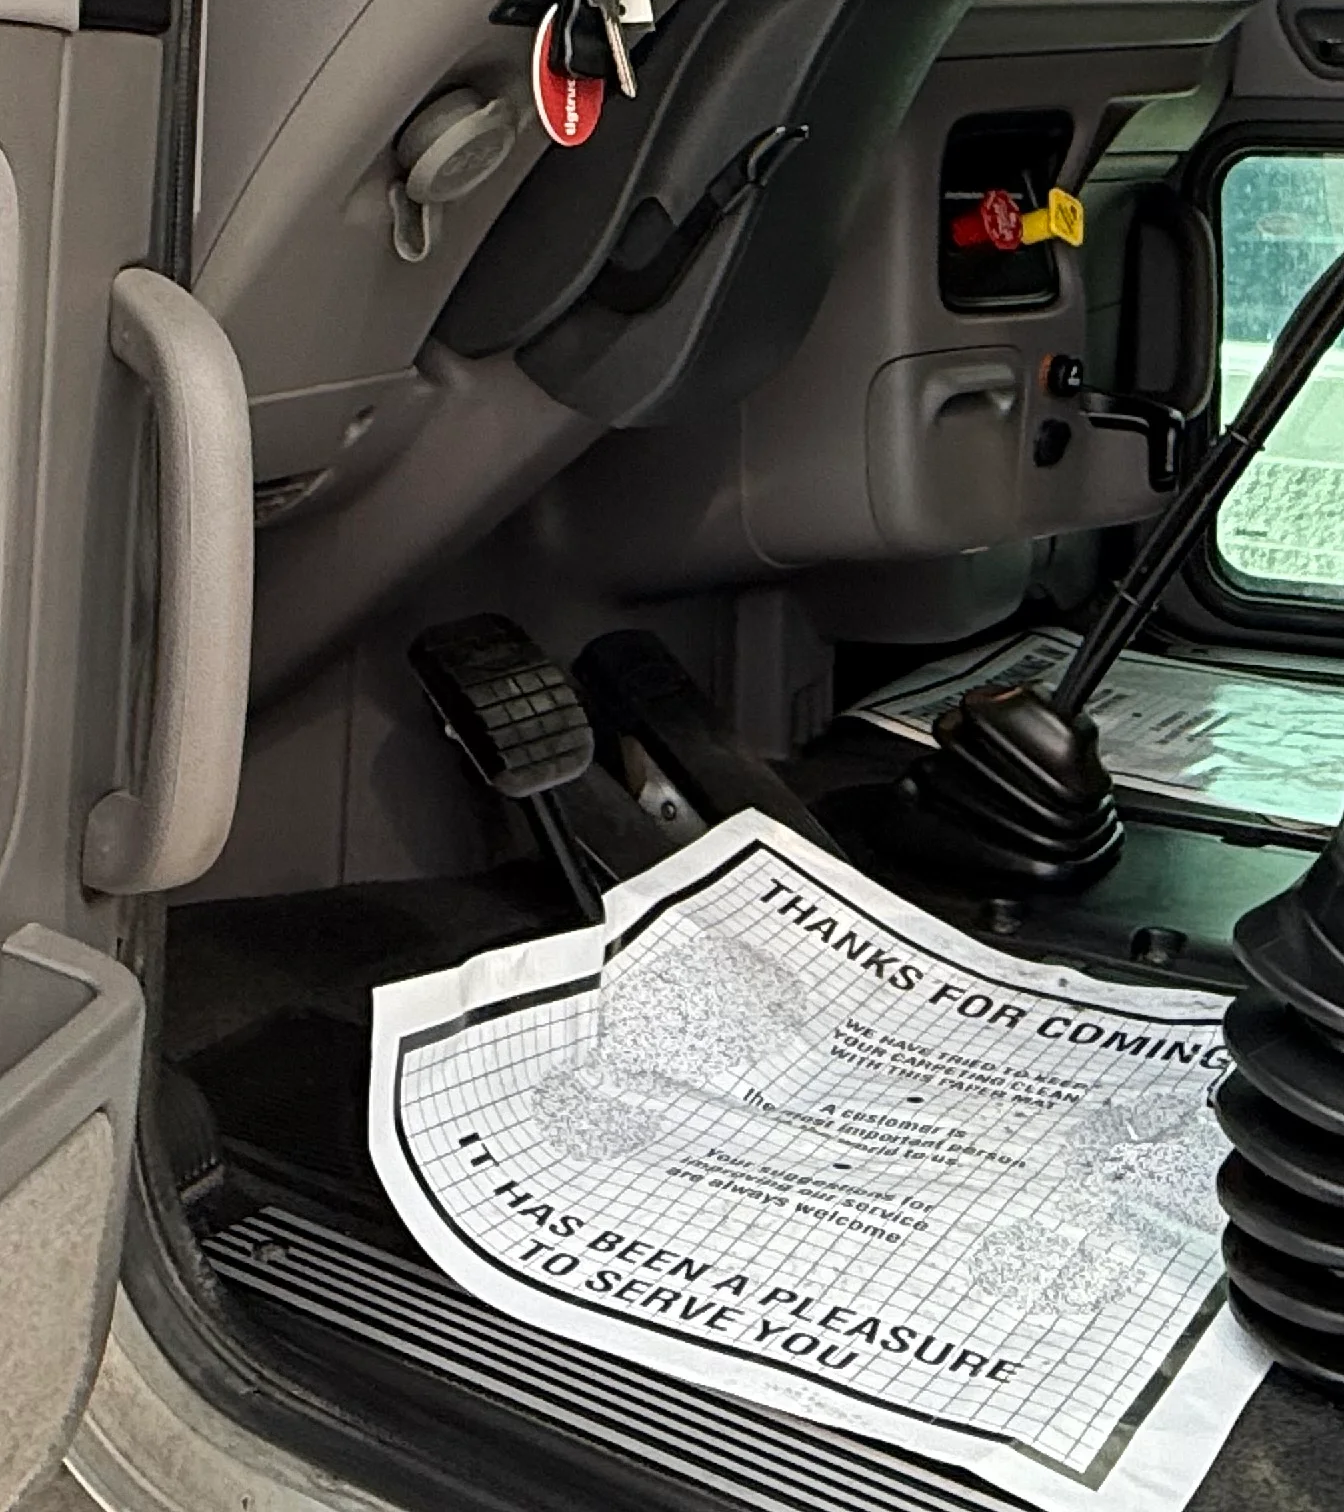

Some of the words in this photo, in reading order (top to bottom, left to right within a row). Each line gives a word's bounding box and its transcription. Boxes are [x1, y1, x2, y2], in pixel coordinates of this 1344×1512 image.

[759, 878, 924, 991] THANKS
[929, 983, 1027, 1029] FOR
[1036, 1016, 1232, 1071] COMING
[830, 1044, 882, 1070] WITH
[887, 1064, 934, 1084] THIS
[938, 1077, 1007, 1099] PAPER
[1011, 1092, 1056, 1110] MAT
[833, 1028, 887, 1057] YOUR
[891, 1053, 1006, 1086] CARPETING
[1010, 1080, 1081, 1103] CLEAN
[845, 1017, 876, 1039] WE
[879, 1035, 933, 1056] HAVE
[937, 1051, 996, 1071] TRIED
[1005, 1066, 1030, 1078] TO
[837, 1122, 944, 1151] important
[947, 1142, 1026, 1168] person
[841, 1109, 941, 1135] customer
[665, 1166, 704, 1183] are
[708, 1176, 790, 1208] always
[794, 1202, 902, 1244] welcome
[707, 1148, 753, 1169] Your
[900, 1196, 936, 1214] for
[840, 1197, 930, 1232] service
[457, 1131, 500, 1169] IT
[493, 1180, 585, 1238] HAS
[586, 1229, 711, 1283] BEEN
[712, 1271, 749, 1297] A
[759, 1285, 1025, 1385] PLEASURE
[518, 1239, 582, 1277] TO
[583, 1269, 746, 1333] SERVE
[754, 1320, 862, 1370] YOU
